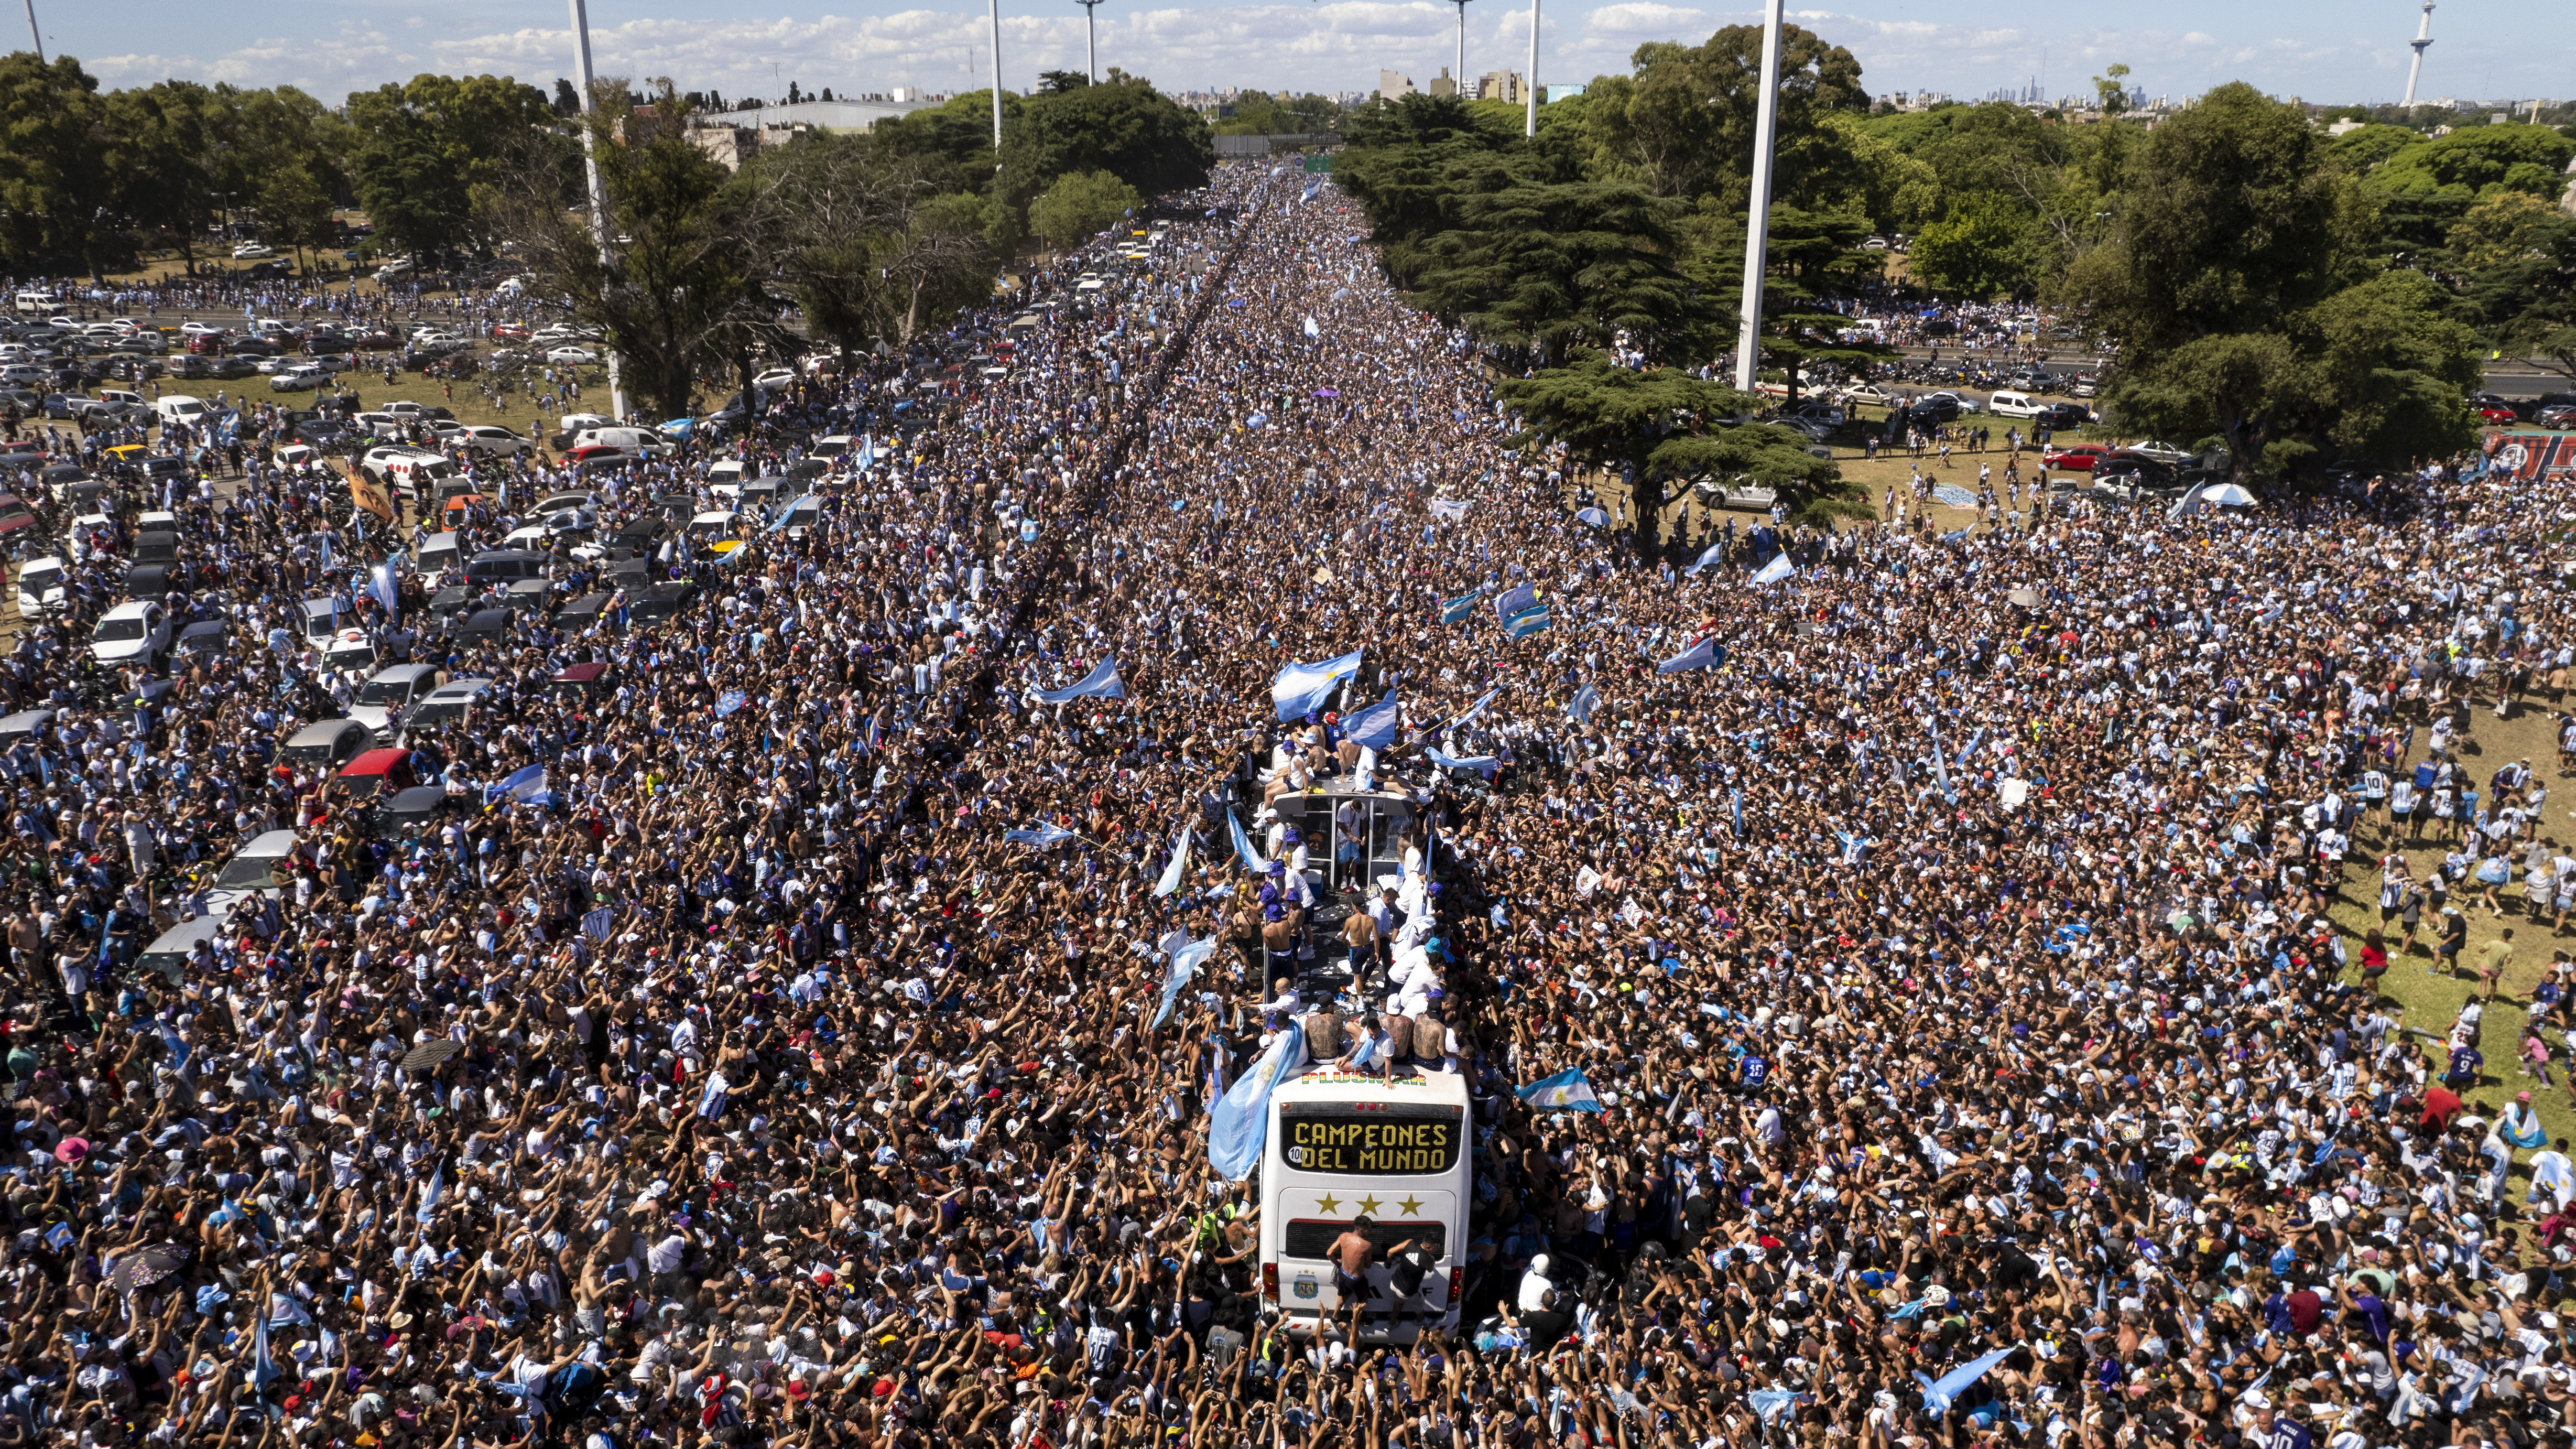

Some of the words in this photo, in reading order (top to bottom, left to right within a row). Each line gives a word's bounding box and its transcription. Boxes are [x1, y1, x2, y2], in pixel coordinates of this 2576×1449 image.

[2225, 682, 2236, 691] 10
[2366, 778, 2379, 788] 10
[596, 916, 603, 931] 7
[1749, 1065, 1764, 1077] 10
[2460, 1060, 2470, 1073] 9
[1302, 1072, 1426, 1086] PLUSMAR
[2344, 1075, 2354, 1086] 10
[1296, 1123, 1447, 1146] CAMPEONES
[1302, 1148, 1348, 1169] DEL
[1360, 1149, 1445, 1169] MUNDO
[2364, 1191, 2377, 1201] 10
[1299, 1283, 1313, 1294] AFA
[1091, 1342, 1110, 1361] 10
[2281, 1423, 2298, 1436] MESSI
[2273, 1431, 2293, 1449] 10
